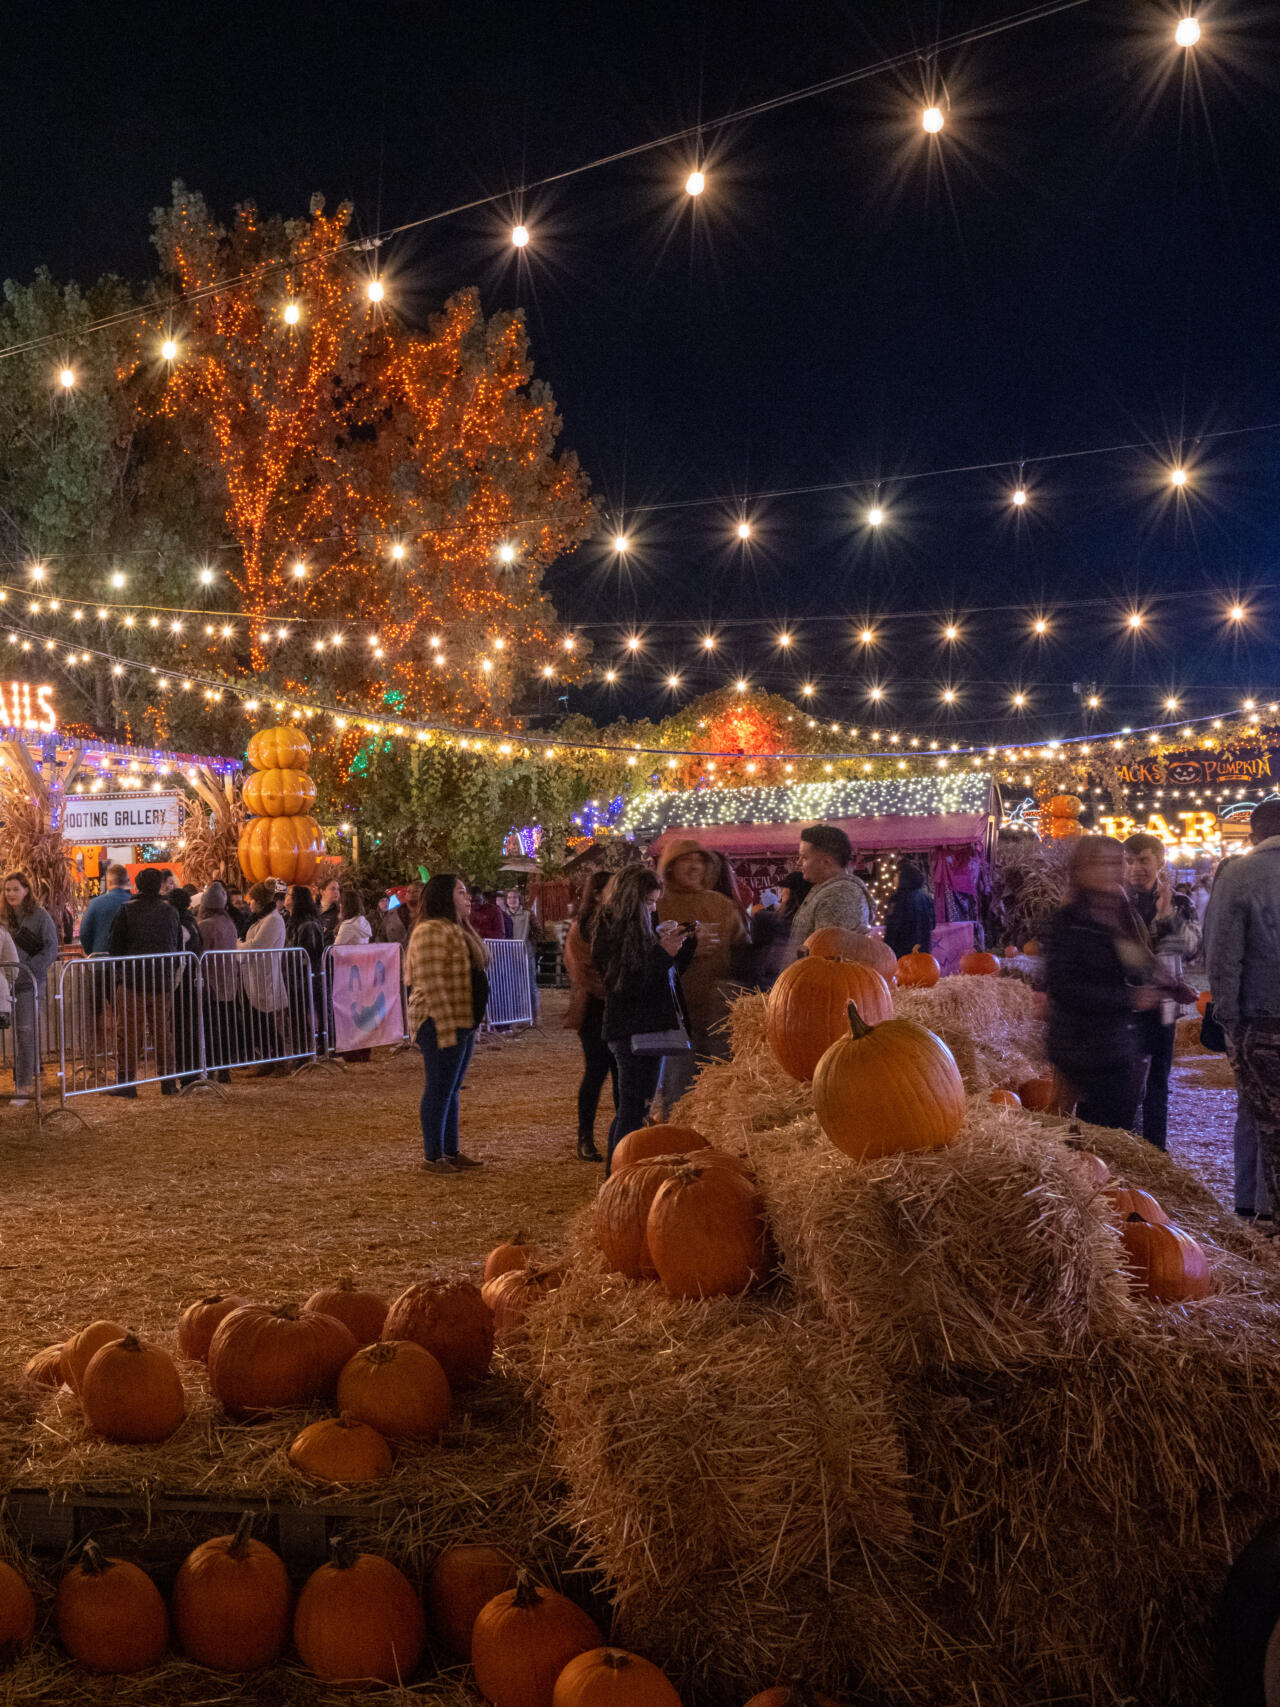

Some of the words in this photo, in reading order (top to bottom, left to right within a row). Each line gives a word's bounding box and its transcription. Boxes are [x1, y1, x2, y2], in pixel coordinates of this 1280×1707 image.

[1202, 754, 1272, 783] PUMPKIN
[64, 811, 108, 829] HOOTING
[115, 809, 166, 826] GALLERY
[1099, 811, 1222, 846] BAR
